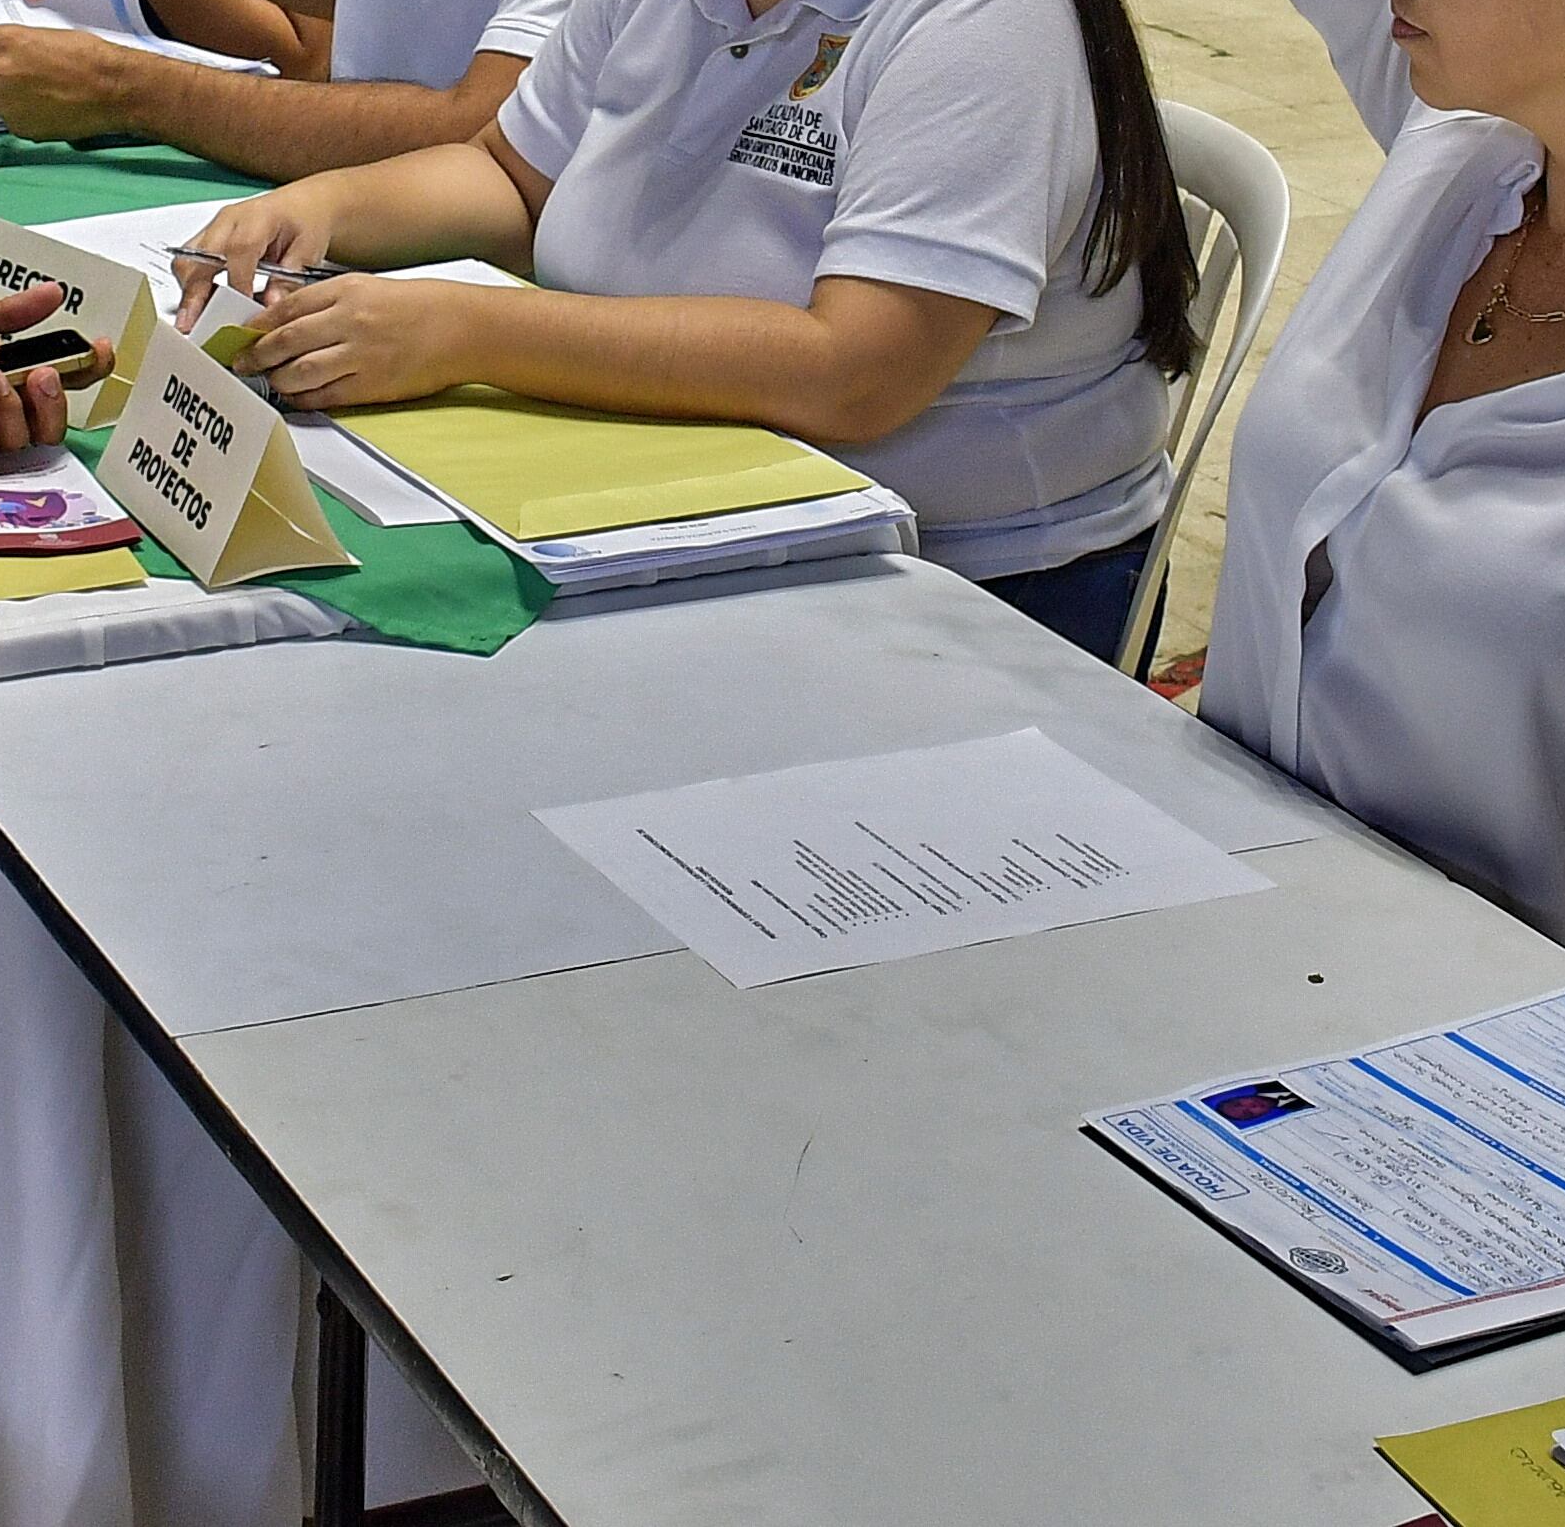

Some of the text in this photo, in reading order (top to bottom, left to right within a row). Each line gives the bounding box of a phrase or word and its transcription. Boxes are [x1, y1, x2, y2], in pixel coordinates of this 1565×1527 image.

[788, 123, 806, 141] DE
[806, 129, 838, 152] CALI
[805, 109, 823, 130] DE
[161, 373, 235, 455] DIRECTOR
[172, 428, 200, 463] DE
[128, 437, 213, 532] PROYECTOS
[1110, 1117, 1230, 1195] HOJA DE VIDA
